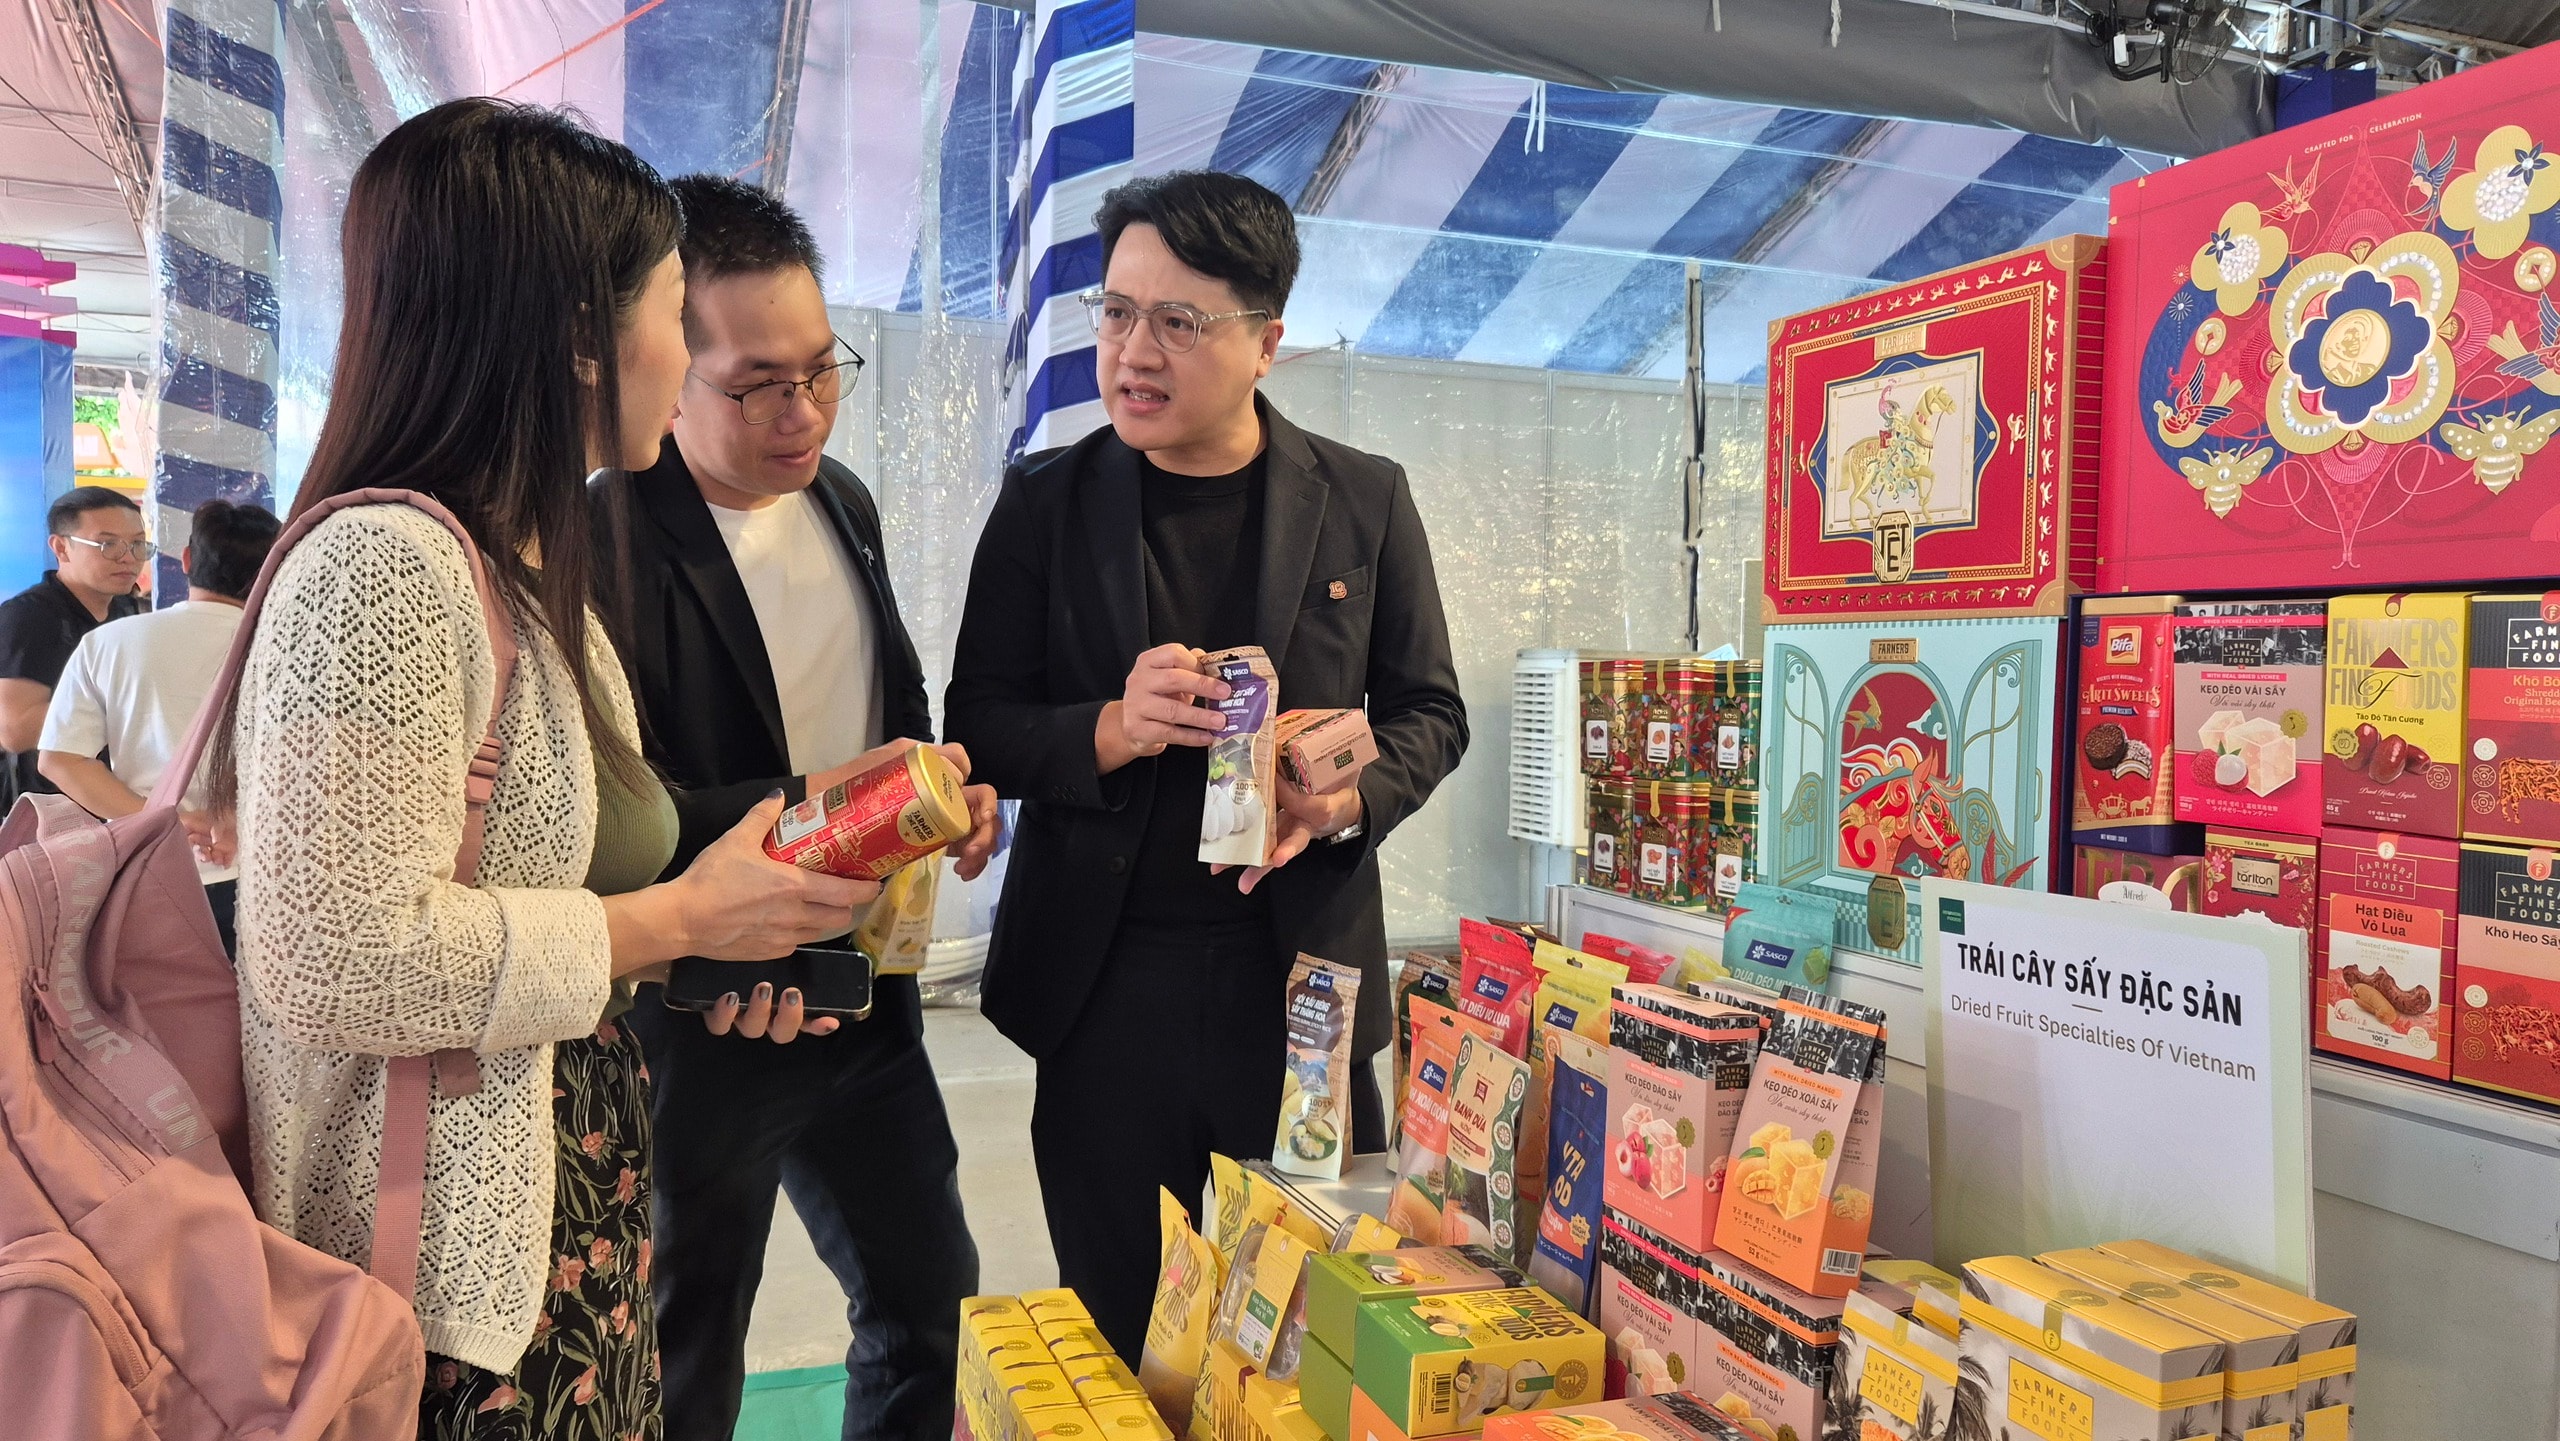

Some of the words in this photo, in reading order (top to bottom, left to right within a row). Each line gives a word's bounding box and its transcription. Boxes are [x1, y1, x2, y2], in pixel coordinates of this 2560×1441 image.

[2369, 112, 2422, 134] CELEBRATION
[2304, 140, 2337, 154] CRAFTED
[2339, 134, 2354, 144] FOR
[1878, 643, 1909, 655] FARMERS
[2110, 636, 2133, 654] Bifa
[2224, 642, 2261, 653] FARMERS
[2332, 618, 2458, 669] FARMERS
[1232, 668, 1249, 676] SASCO
[2200, 684, 2219, 695] KẸO
[2330, 668, 2375, 707] FINE
[2504, 696, 2543, 707] Original
[912, 810, 937, 839] FARMERS
[912, 825, 929, 843] FOODS
[2358, 862, 2414, 879] FARMERS
[2372, 870, 2398, 882] FINE
[2237, 871, 2273, 887] tarlton
[2366, 881, 2404, 893] FOODS
[2519, 896, 2555, 910] FINE
[2383, 906, 2413, 923] Điều
[2356, 940, 2381, 950] Roasted
[2513, 930, 2538, 944] Heo
[1764, 950, 1788, 962] SASCO
[1316, 978, 1331, 988] SASCO
[1430, 980, 1445, 989] SASCO
[1488, 984, 1505, 996] SASCO
[1957, 941, 2004, 978] TRÁI
[2012, 950, 2056, 988] CÂY
[2064, 956, 2111, 999] SẤY
[2120, 970, 2173, 1015] ĐẶC
[2183, 979, 2242, 1027] SẢN
[1559, 1014, 1573, 1024] SASCO
[1792, 1004, 1807, 1012] DRIED
[1808, 1008, 1825, 1018] MANGO
[1826, 1014, 1841, 1022] JELLY
[1842, 1018, 1860, 1027] CANDY
[1951, 994, 1991, 1019] Dried
[1996, 1004, 2034, 1029] Fruit
[2038, 1014, 2136, 1053] Specialties
[2140, 1037, 2164, 1059] Of
[2168, 1044, 2257, 1082] Vietnam
[2372, 1034, 2383, 1042] 100
[2384, 1037, 2390, 1045] g
[1800, 1046, 1829, 1061] FARMERS
[1800, 1059, 1821, 1070] FOODS
[1433, 1072, 1444, 1085] SASCO
[1625, 1072, 1638, 1087] KẸO
[1717, 1068, 1749, 1078] FARMERS
[1720, 1080, 1744, 1088] FOODS
[1774, 1069, 1786, 1077] WITH
[1786, 1074, 1799, 1083] REAL
[1800, 1078, 1816, 1089] DRIED
[1816, 1084, 1836, 1095] MANGO
[1764, 1079, 1780, 1092] KẸO
[1781, 1084, 1799, 1099] DẺO
[1799, 1090, 1820, 1107] XOÀI
[1820, 1096, 1839, 1113] SẤY
[1572, 1224, 1587, 1236] HIGH
[1722, 1284, 1735, 1296] DRIED
[1736, 1292, 1752, 1306] MANGO
[1754, 1304, 1768, 1314] JELLY
[1768, 1311, 1785, 1324] CANDY
[1491, 1288, 1585, 1338] FARMERS
[1736, 1325, 1765, 1348] FARMERS
[1722, 1346, 1734, 1356] WITH
[1734, 1353, 1746, 1366] REAL
[1746, 1361, 1761, 1375] DRIED
[1761, 1371, 1780, 1386] MANGO
[1716, 1356, 1731, 1372] KẸO
[1732, 1364, 1747, 1383] DẺO
[1768, 1387, 1785, 1407] SẤY
[1867, 1362, 1918, 1398] FARMERS
[1876, 1375, 1903, 1397] FINE
[1869, 1384, 1907, 1413] FOODS
[2013, 1378, 2089, 1426] FARMERS
[2030, 1395, 2067, 1424] FINE
